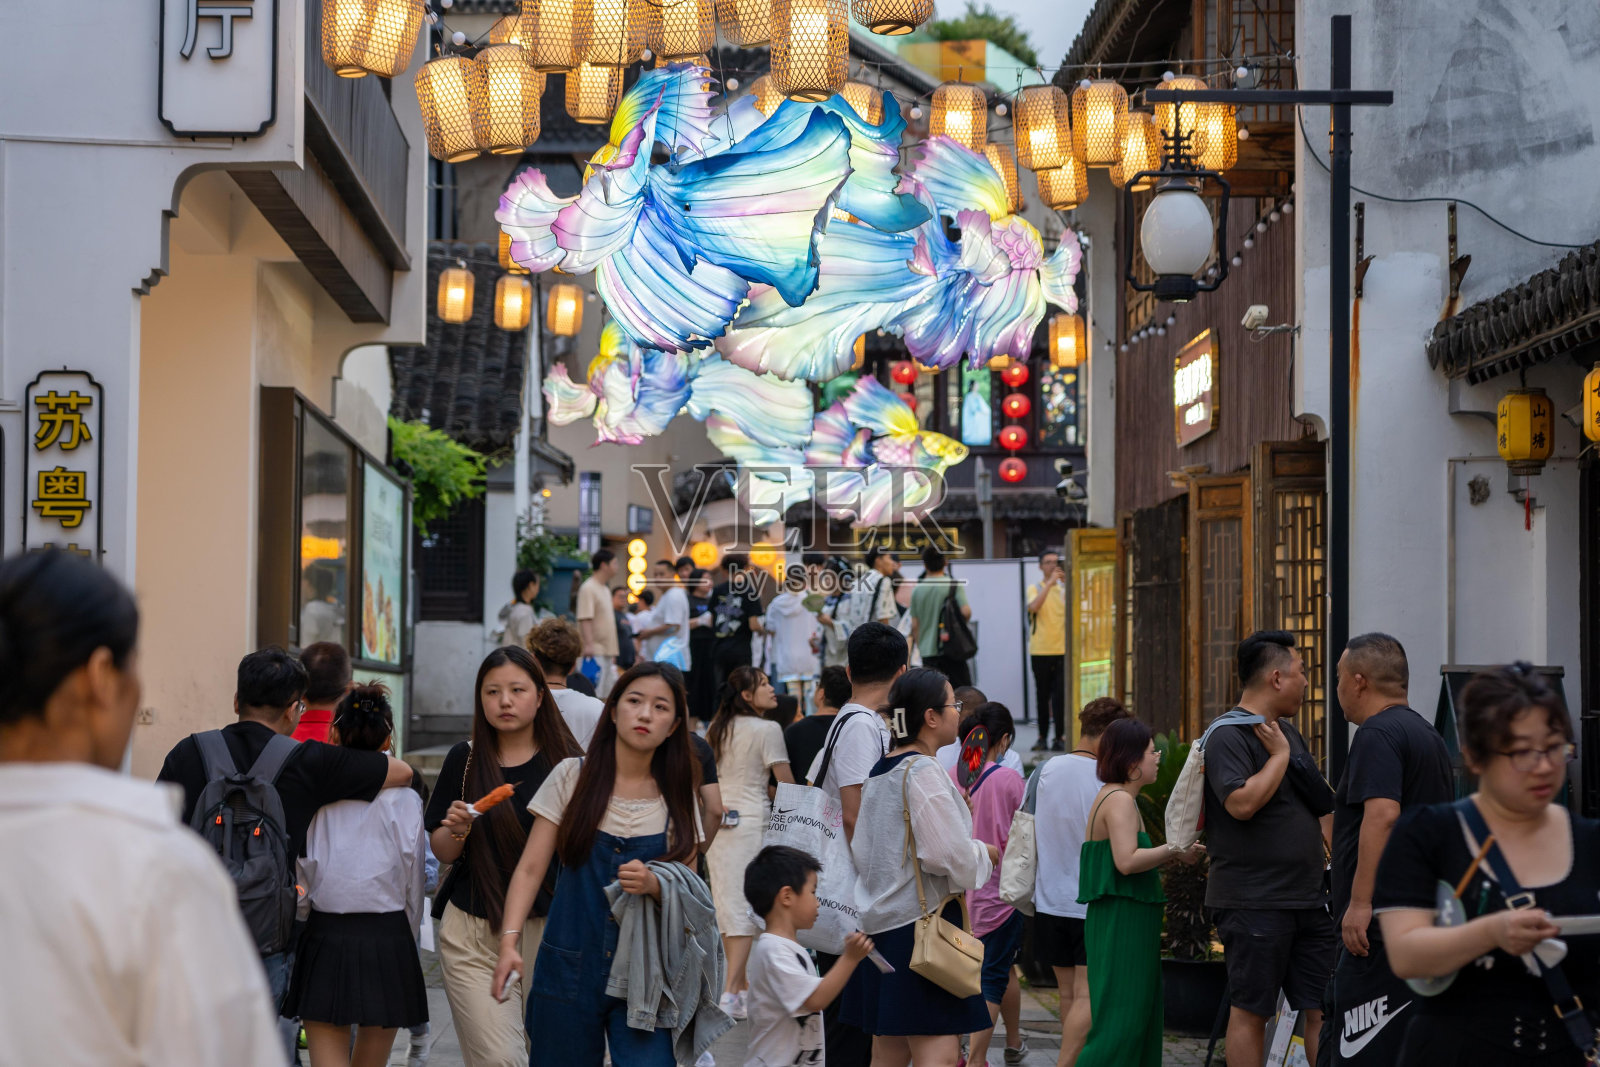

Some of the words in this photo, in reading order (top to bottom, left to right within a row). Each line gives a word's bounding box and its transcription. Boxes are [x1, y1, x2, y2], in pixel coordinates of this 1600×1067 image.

[180, 0, 253, 60] 厅
[32, 390, 93, 556] 苏粤
[1344, 994, 1389, 1038] NIKE
